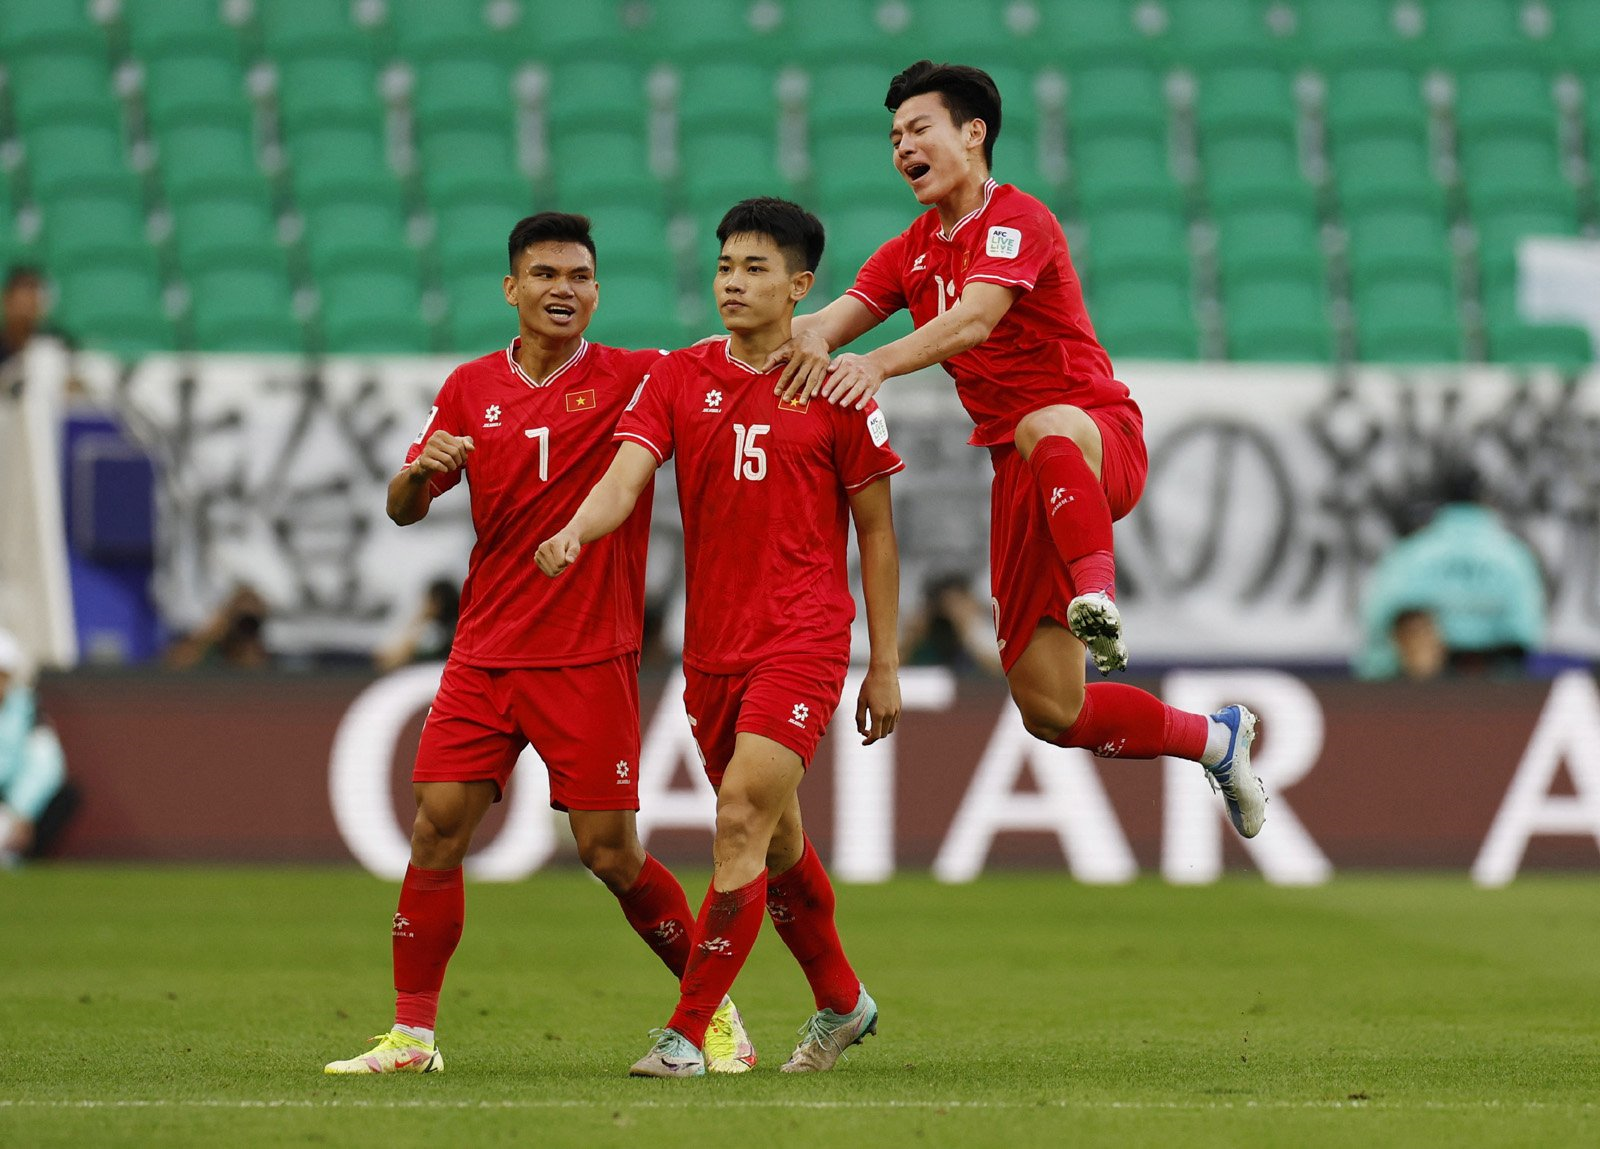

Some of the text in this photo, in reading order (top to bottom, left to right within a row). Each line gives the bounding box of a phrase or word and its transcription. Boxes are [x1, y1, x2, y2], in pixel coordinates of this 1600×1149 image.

[991, 236, 1015, 247] LIVE
[993, 230, 1007, 238] AFC
[524, 426, 550, 482] 7
[733, 423, 771, 481] 15
[328, 667, 1334, 886] QATAR
